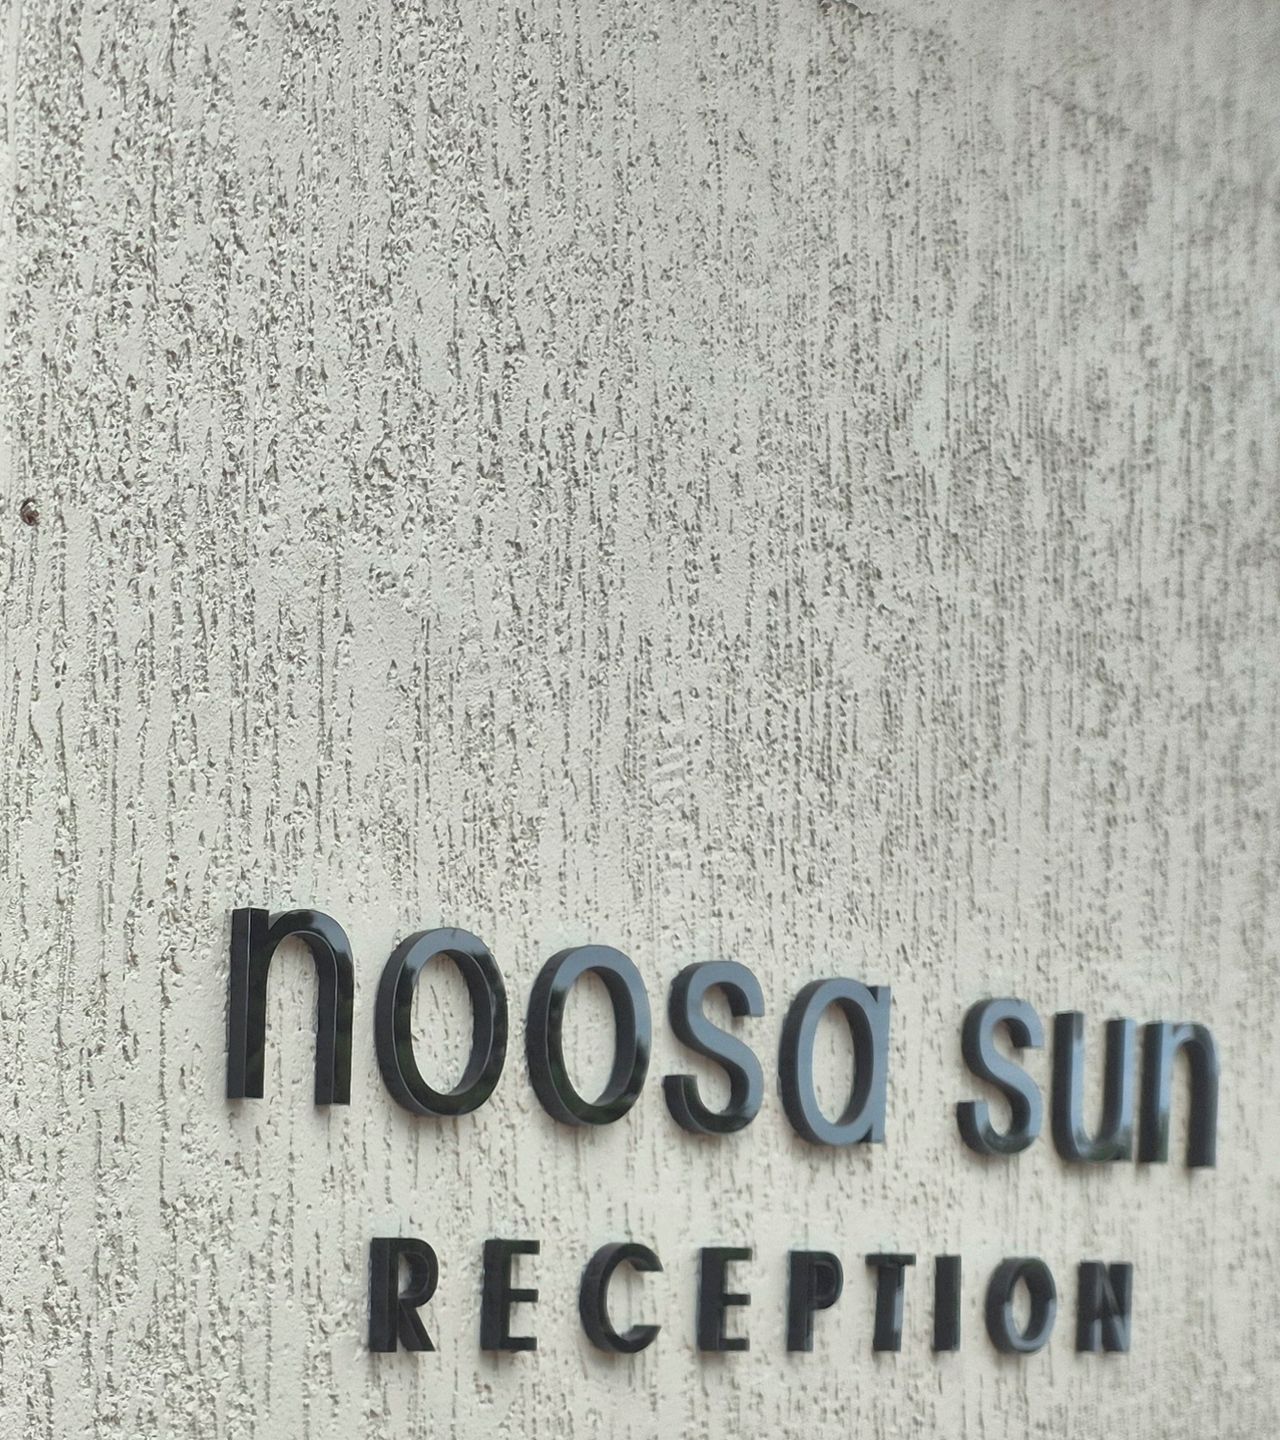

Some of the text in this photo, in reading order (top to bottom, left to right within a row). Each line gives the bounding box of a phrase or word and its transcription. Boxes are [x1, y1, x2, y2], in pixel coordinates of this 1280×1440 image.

[225, 907, 1221, 1168] noosa sun
[368, 1236, 1134, 1355] RECEPTION
